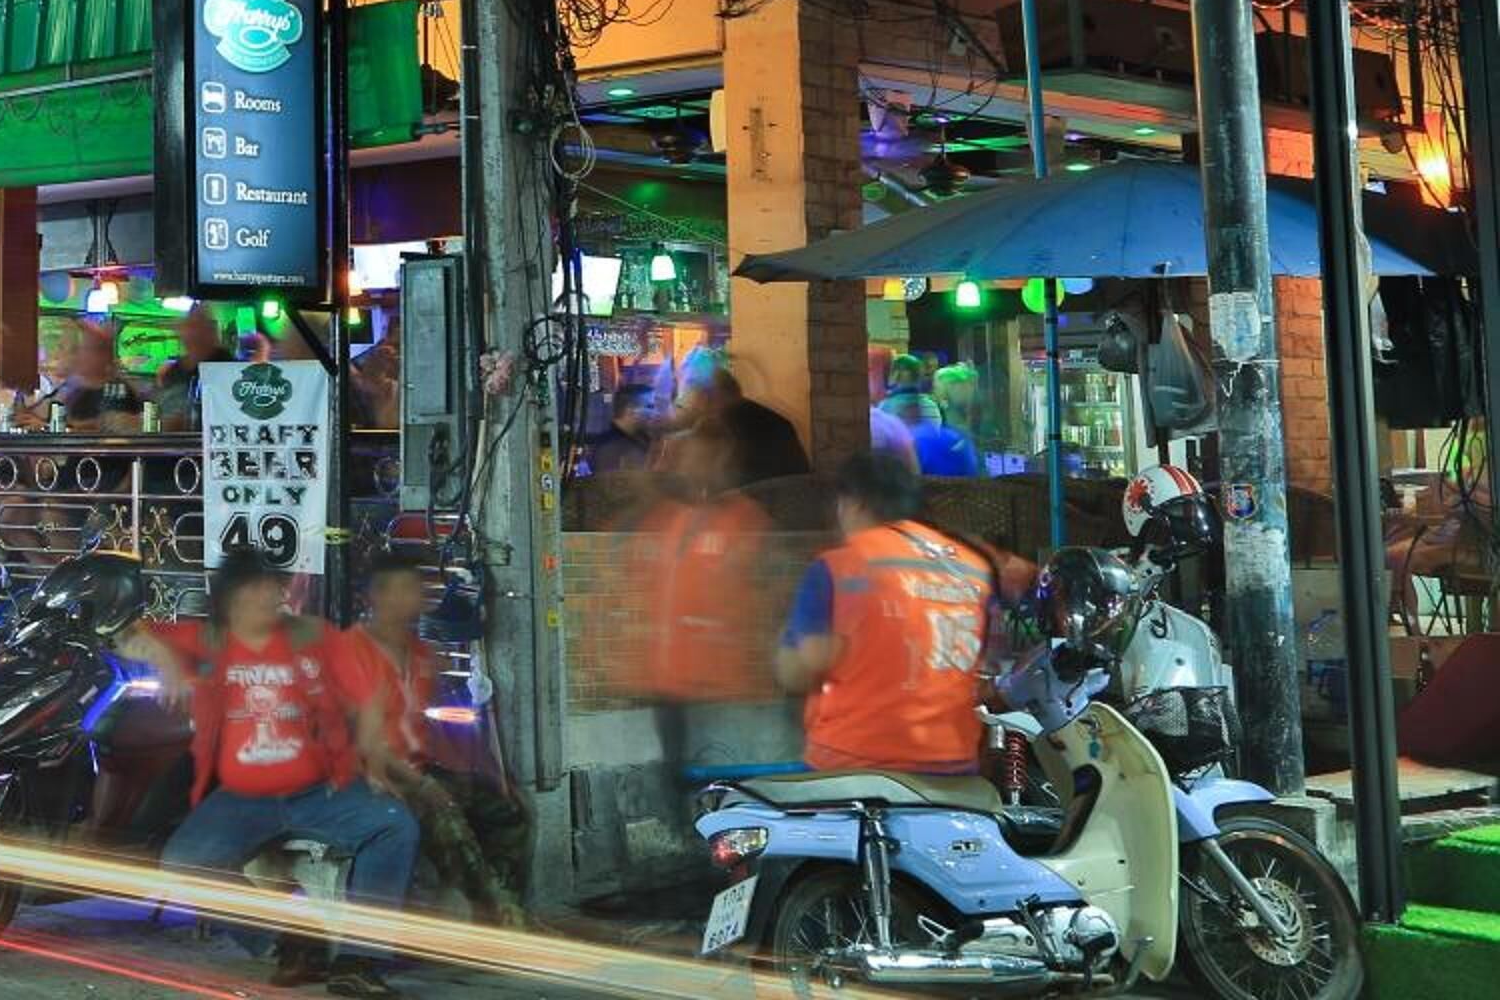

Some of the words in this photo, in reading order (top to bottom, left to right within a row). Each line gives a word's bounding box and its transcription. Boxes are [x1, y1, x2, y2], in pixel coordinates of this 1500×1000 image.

[234, 90, 282, 112] Rooms
[235, 137, 260, 157] Bar
[235, 182, 309, 205] Restaurant
[236, 228, 271, 248] Golf
[211, 450, 319, 480] BEER
[222, 485, 307, 505] ONLY
[220, 511, 299, 568] 49
